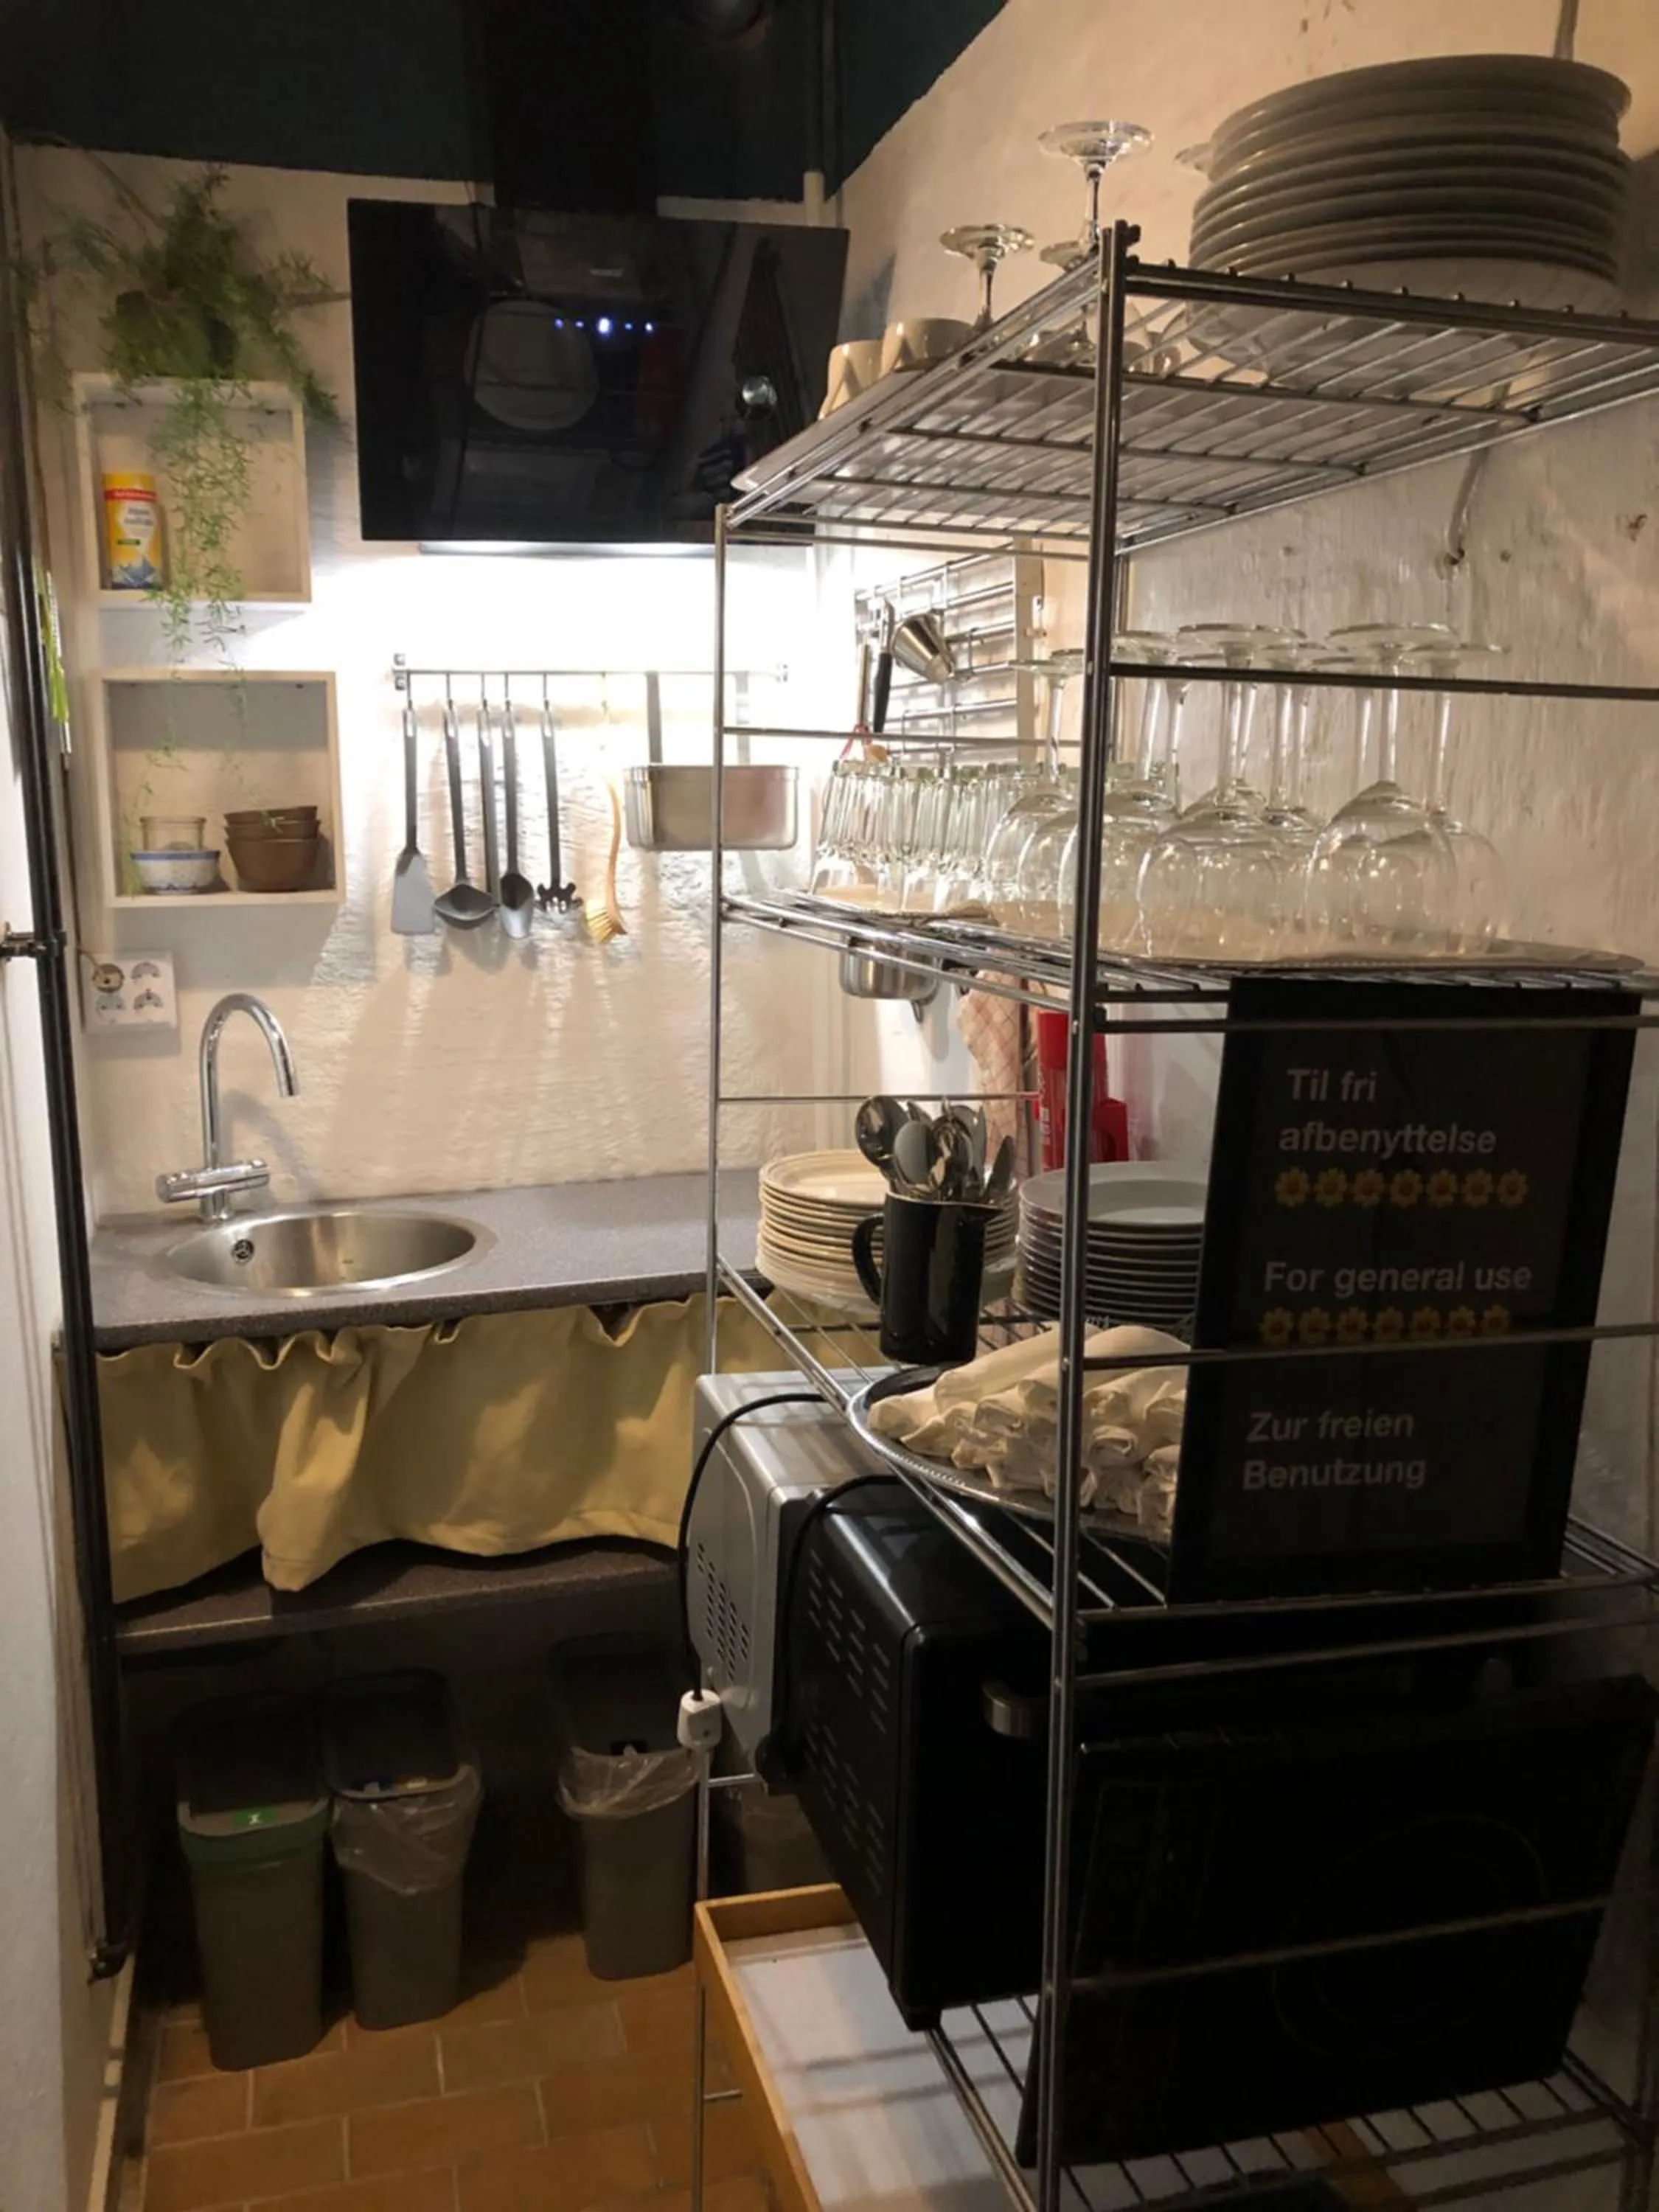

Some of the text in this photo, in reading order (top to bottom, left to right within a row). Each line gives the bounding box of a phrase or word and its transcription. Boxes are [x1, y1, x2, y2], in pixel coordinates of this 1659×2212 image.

[1287, 1068, 1377, 1102] Til fri
[1279, 1121, 1497, 1159] afbenyttelse
[1265, 1260, 1532, 1298] For general use
[1246, 1411, 1413, 1442] Zur freien
[1242, 1458, 1426, 1489] Benutzung
